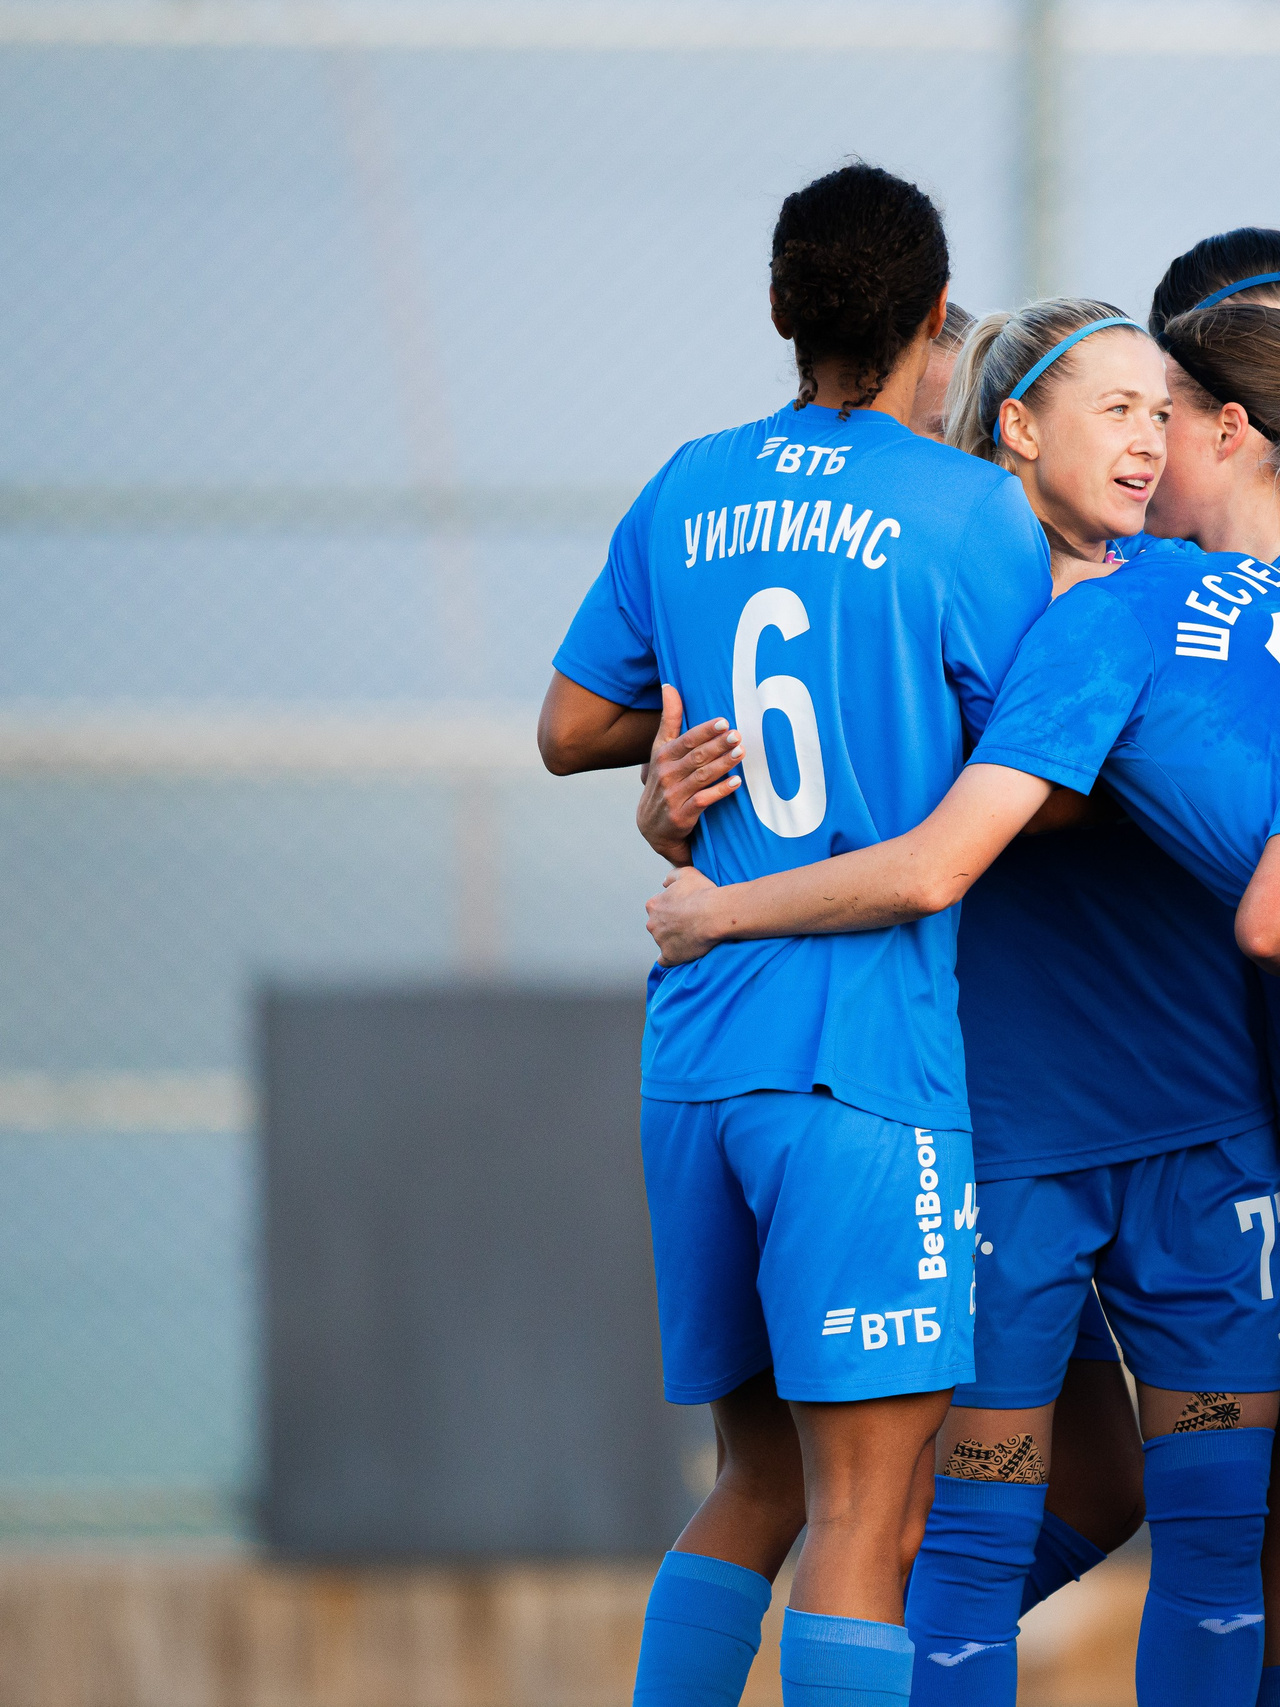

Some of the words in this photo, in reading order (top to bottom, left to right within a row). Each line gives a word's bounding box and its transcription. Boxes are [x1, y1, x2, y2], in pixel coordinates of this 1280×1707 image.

[775, 443, 853, 476] ВТБ
[684, 499, 901, 570] УИЛЛИАМС
[732, 587, 827, 838] 6
[861, 1307, 941, 1350] ВТБ
